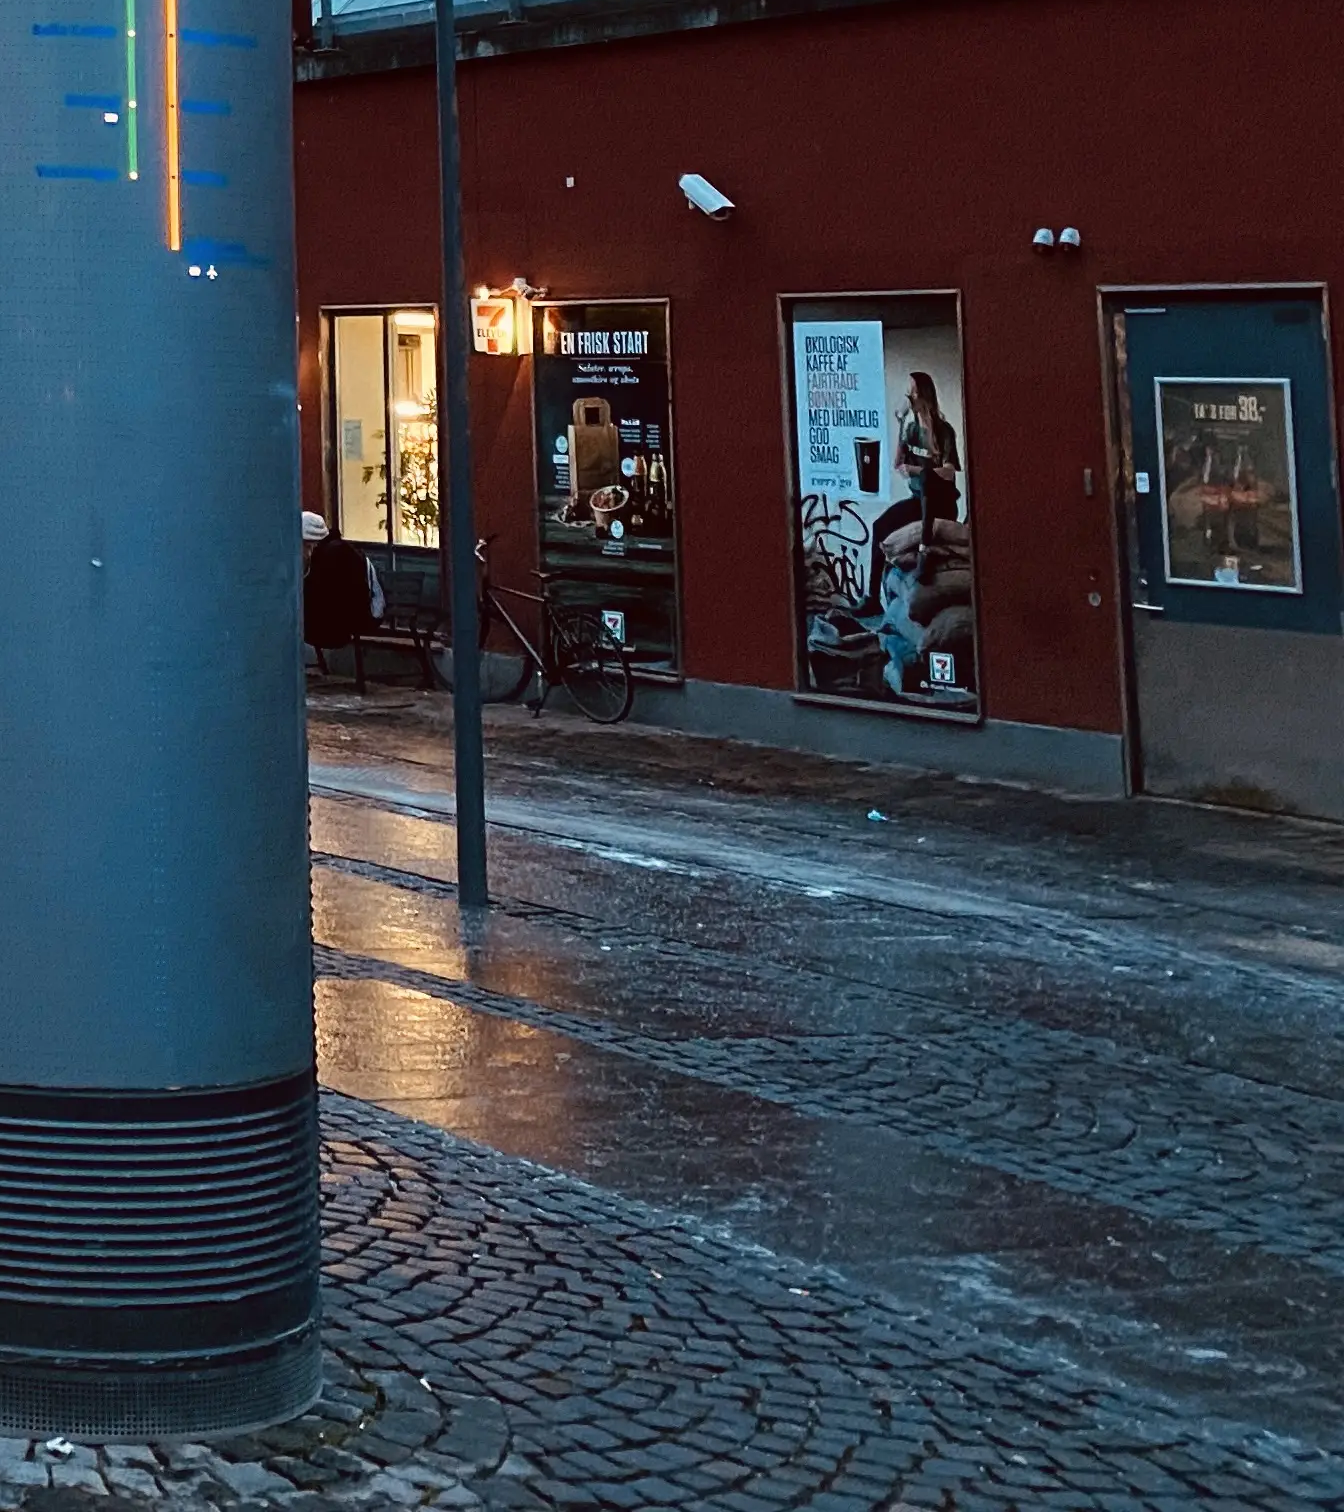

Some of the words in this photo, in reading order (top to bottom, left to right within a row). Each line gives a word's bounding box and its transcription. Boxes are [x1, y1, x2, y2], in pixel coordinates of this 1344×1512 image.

[476, 305, 506, 352] 7
[560, 331, 575, 355] EN
[578, 331, 611, 355] FRISK
[613, 331, 649, 355] START
[805, 335, 859, 354] ØKOLOGISK
[806, 354, 834, 372] KAFFE
[837, 354, 848, 372] AF
[807, 373, 860, 391] FAIRTRADE
[809, 409, 830, 427] MED
[832, 409, 879, 428] URIMELIG
[809, 427, 829, 445] GOD
[810, 445, 840, 464] SMAG
